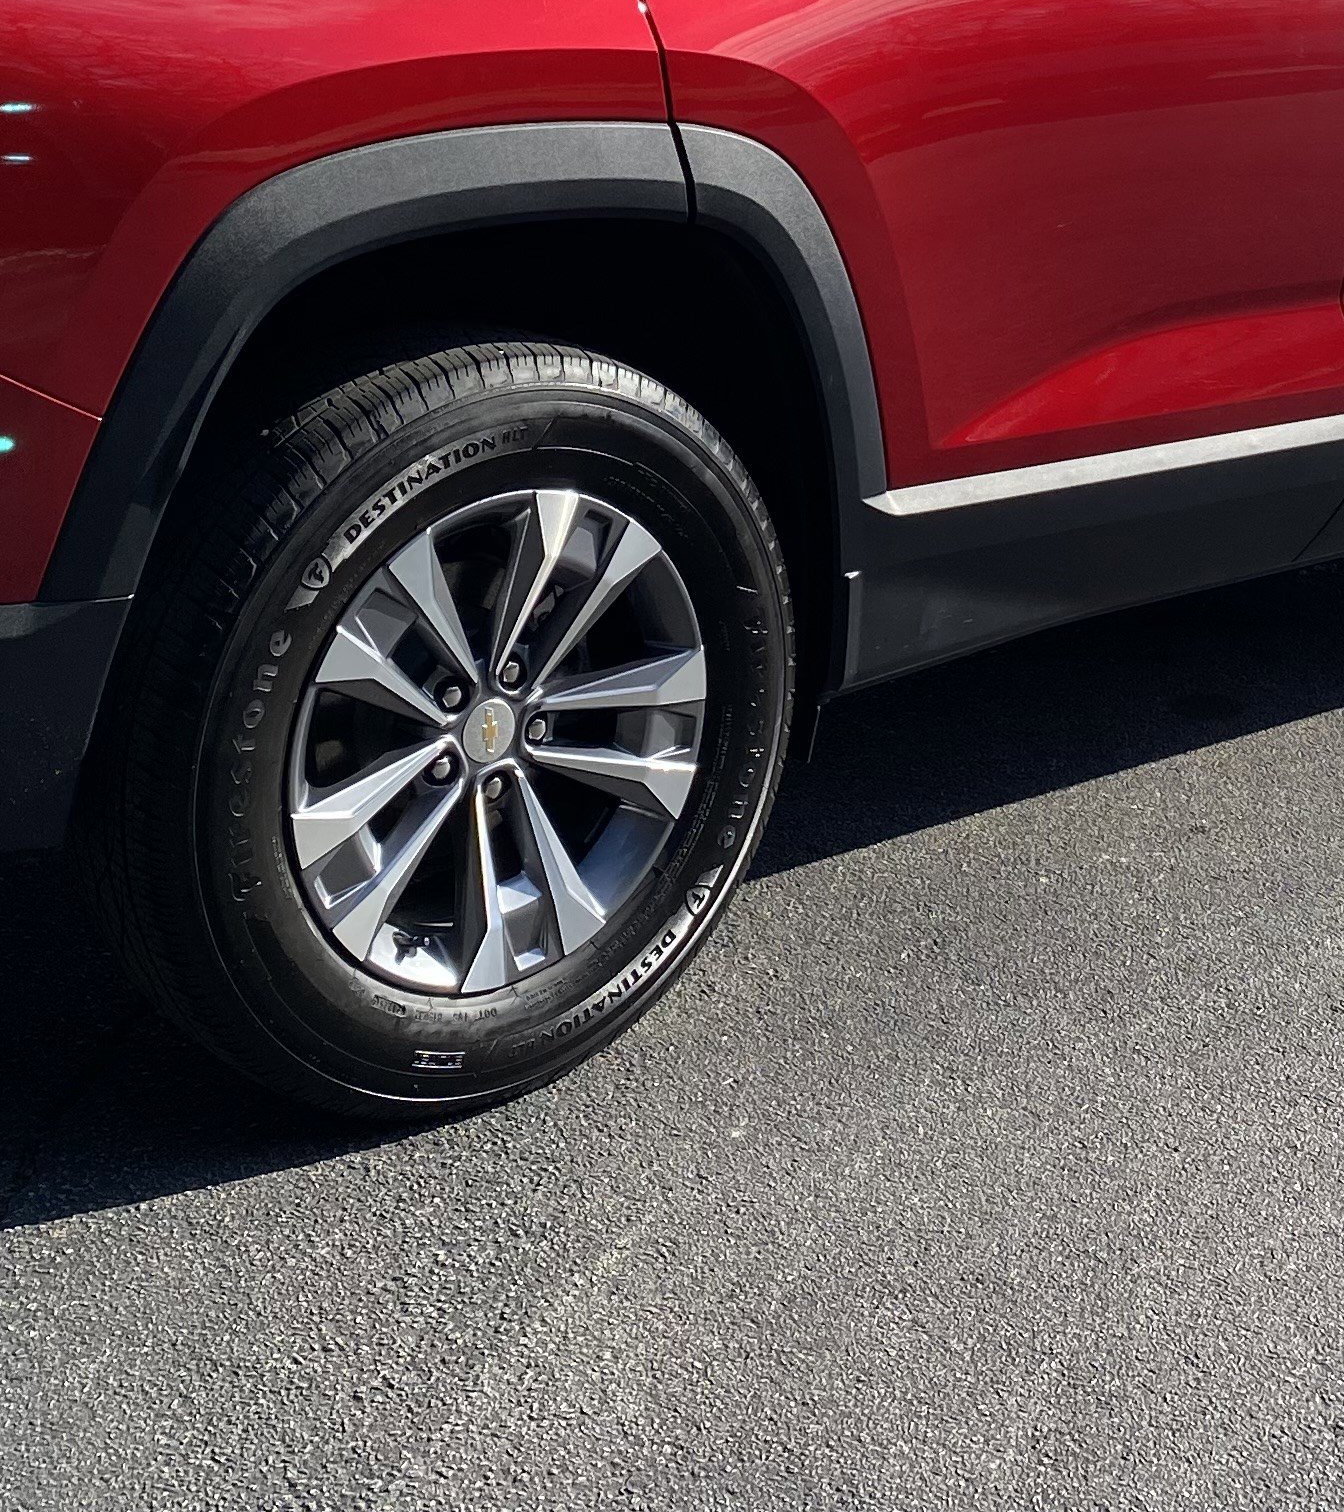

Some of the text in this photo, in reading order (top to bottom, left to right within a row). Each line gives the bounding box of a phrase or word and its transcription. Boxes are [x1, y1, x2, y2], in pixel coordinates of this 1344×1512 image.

[343, 434, 497, 545] DESTINATION
[227, 629, 293, 902] Firestone
[717, 619, 769, 850] Firtone
[538, 928, 677, 1046] DESTINATION
